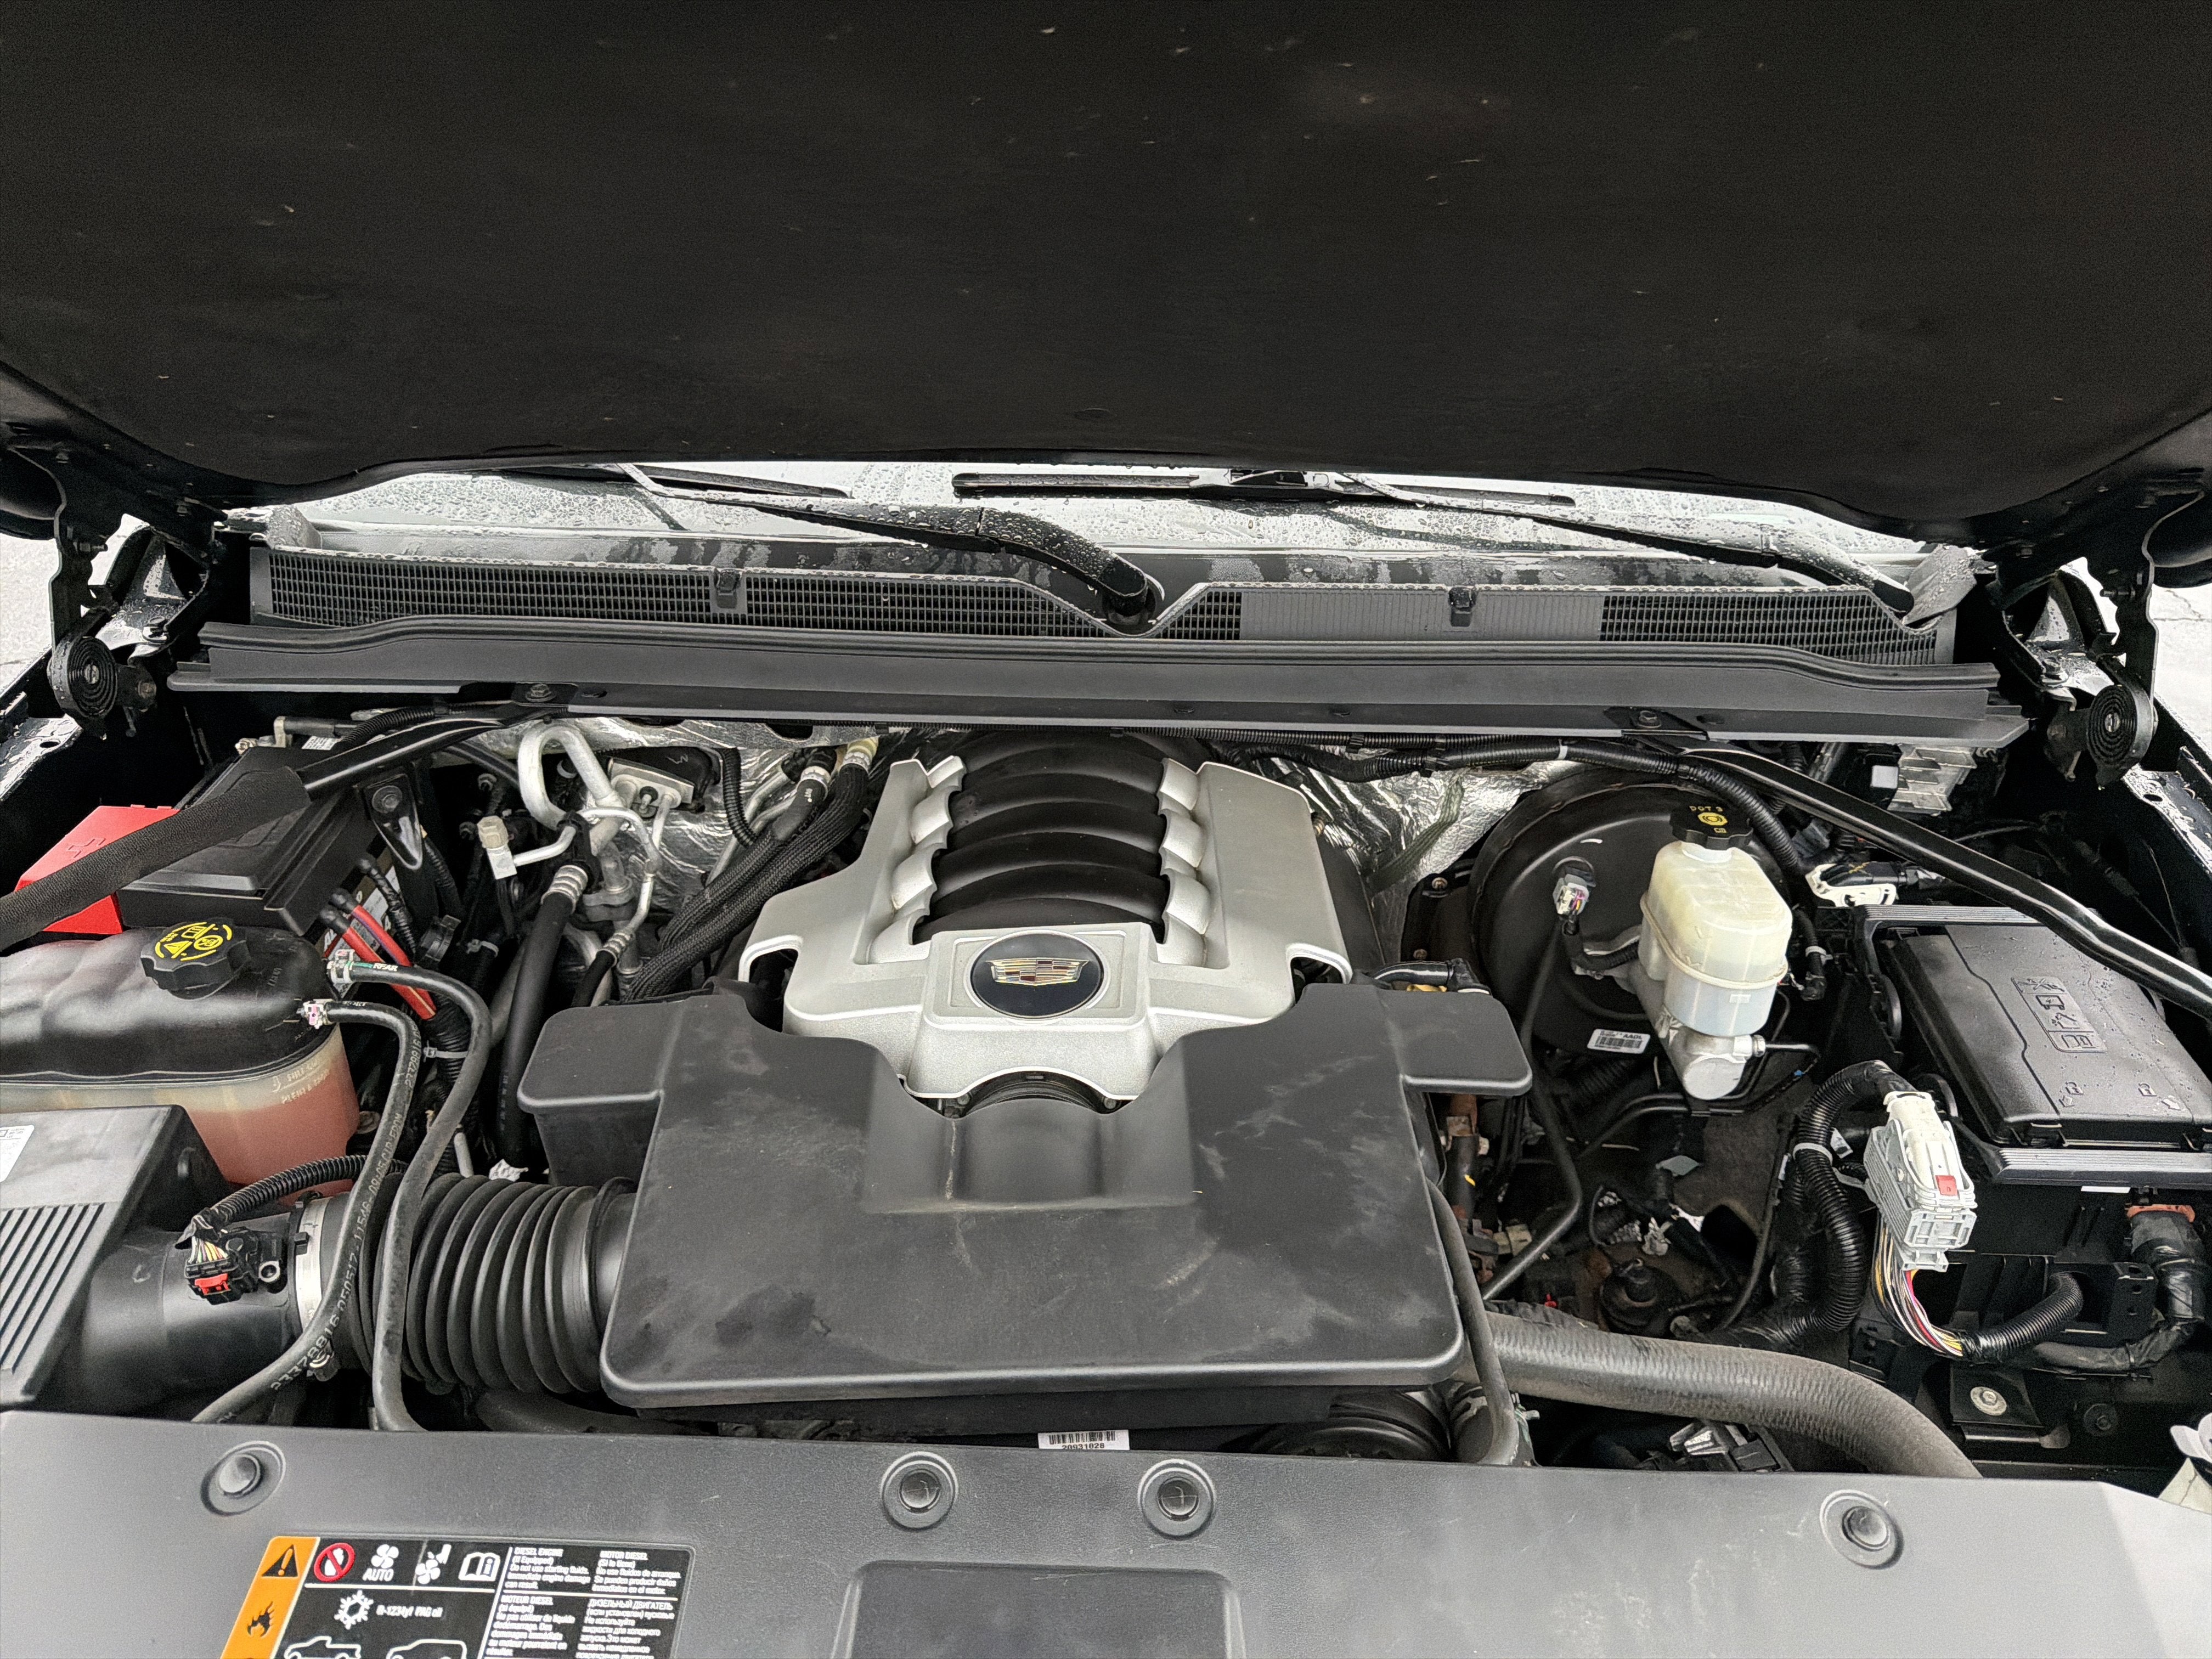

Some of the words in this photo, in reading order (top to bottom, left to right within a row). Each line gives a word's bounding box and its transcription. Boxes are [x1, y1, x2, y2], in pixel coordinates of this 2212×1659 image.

[373, 963, 398, 972] REAR
[514, 1547, 537, 1555] DIESEL
[538, 1548, 563, 1557] ENGINE
[600, 1550, 624, 1559] MOTOR
[625, 1551, 648, 1560] DIESEL
[363, 1568, 394, 1582] AUTO
[544, 1565, 569, 1575] starting
[542, 1574, 564, 1583] engine
[565, 1575, 591, 1584] damage
[594, 1575, 603, 1583] Se
[501, 1595, 529, 1604] MOTEUR
[530, 1596, 553, 1605] DIESEL
[588, 1599, 632, 1608] ДИЗЕЛЬНЫЙ
[633, 1600, 673, 1610] ДВИГАТЕЛЬ
[432, 1607, 443, 1617] oil
